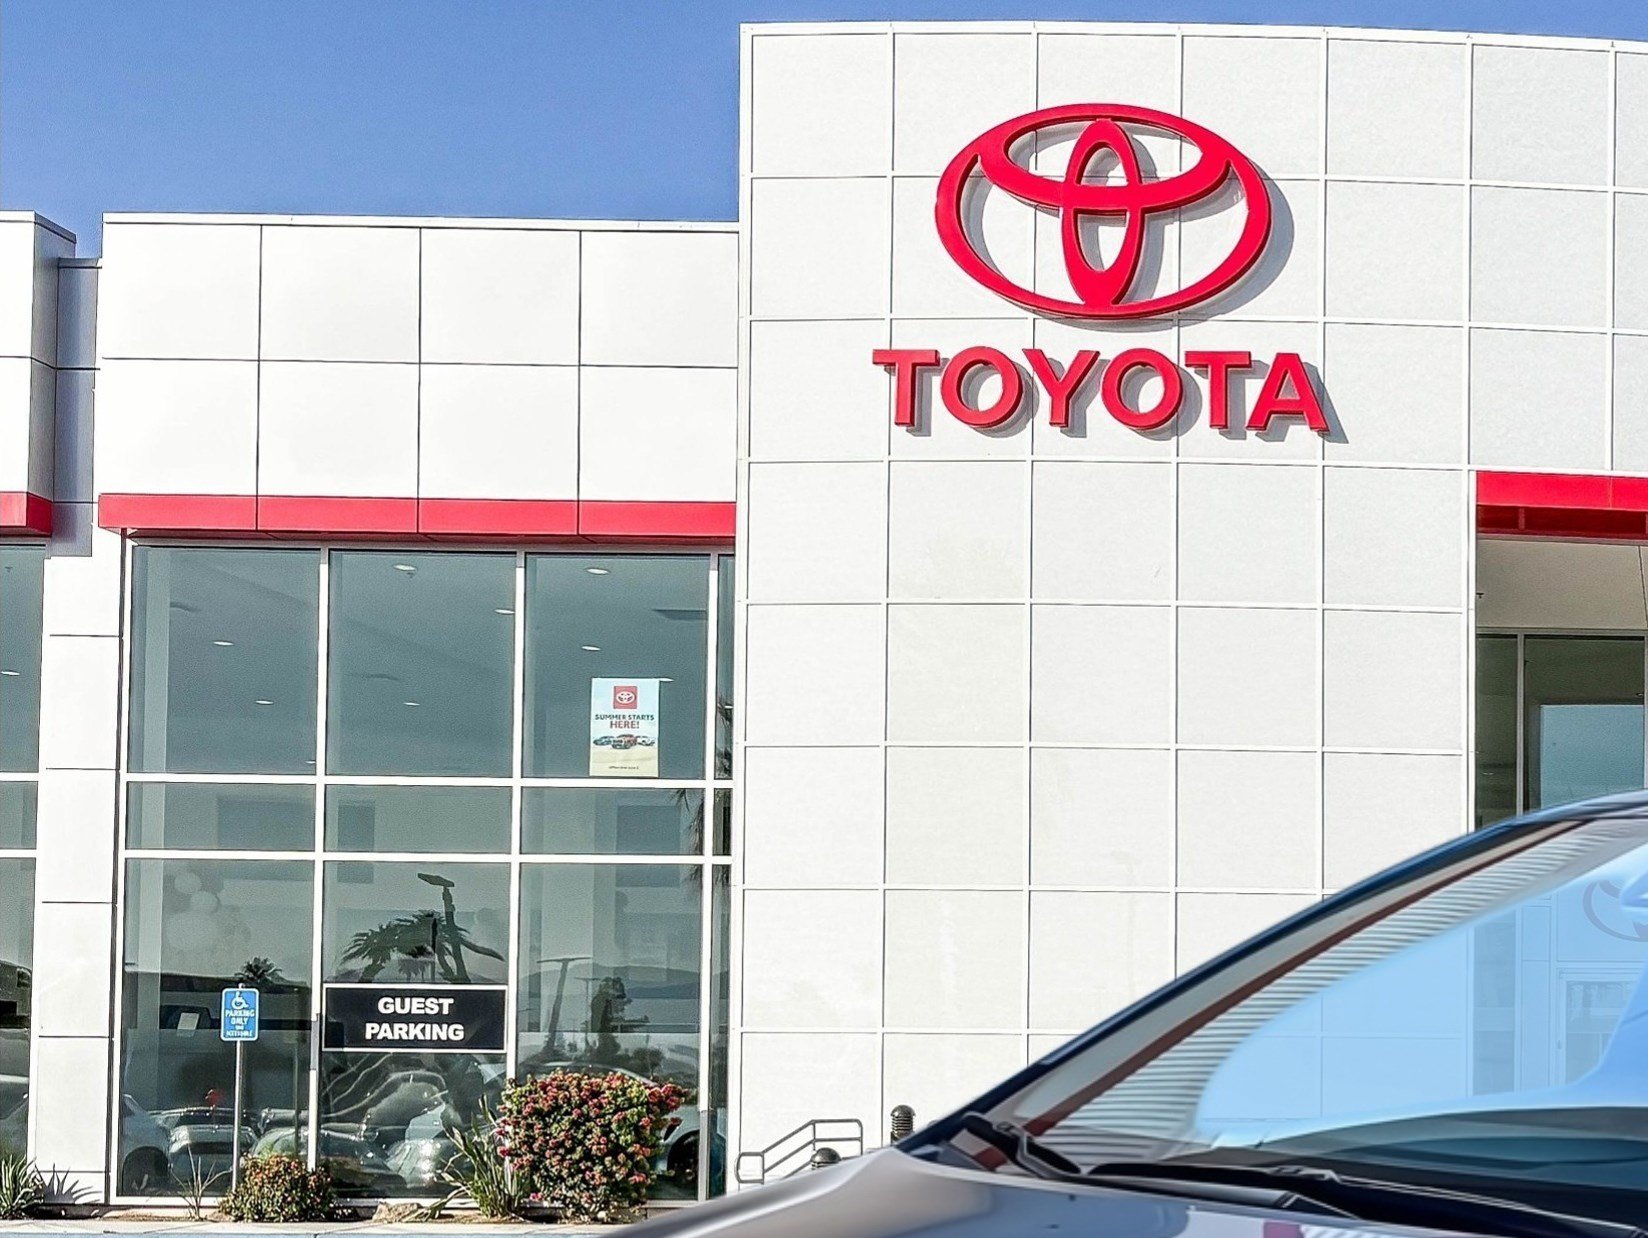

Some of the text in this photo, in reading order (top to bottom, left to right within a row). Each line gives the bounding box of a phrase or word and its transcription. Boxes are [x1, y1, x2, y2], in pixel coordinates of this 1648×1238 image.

[872, 345, 1330, 436] TOYOTA
[609, 720, 640, 729] HERE!
[377, 996, 455, 1015] GUEST
[364, 1022, 465, 1041] PARKING
